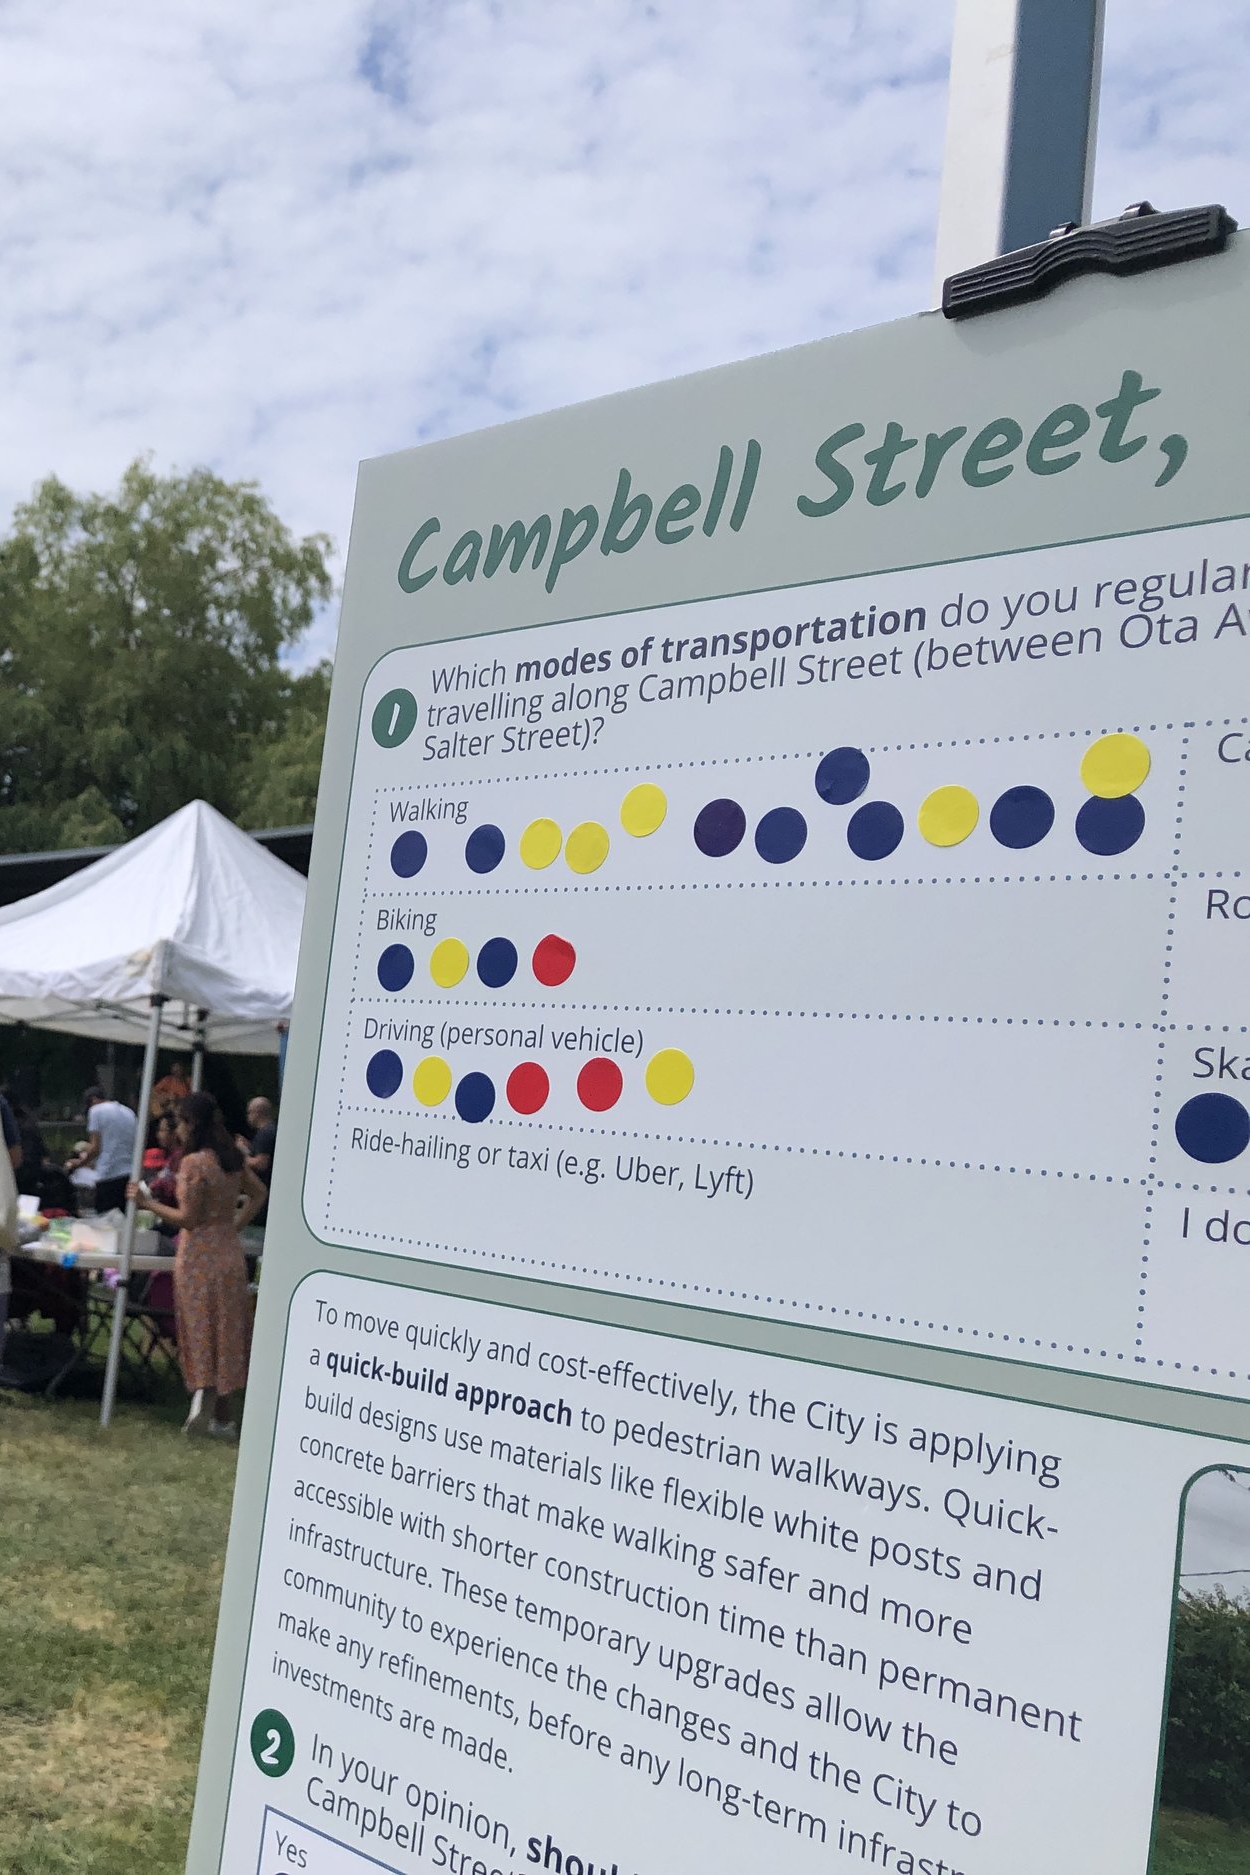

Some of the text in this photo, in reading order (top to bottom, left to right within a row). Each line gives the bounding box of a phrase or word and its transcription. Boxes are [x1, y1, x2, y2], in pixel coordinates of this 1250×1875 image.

[398, 370, 1188, 594] Campbell Street,
[427, 603, 1250, 727] travelling along Campbell Street (between Ota A
[432, 659, 506, 694] Which
[515, 647, 612, 683] modes
[621, 636, 655, 668] of
[661, 605, 926, 663] transportation
[941, 593, 989, 627] do
[1000, 586, 1078, 630] you
[423, 716, 604, 761] Salter Street)?
[390, 798, 469, 825] Walking
[377, 908, 438, 937] Biking
[364, 1018, 643, 1058] Driving (personal vehicle)
[352, 1128, 753, 1200] Ride-hailing or taxi (e.g. Uber, Lyft)
[1183, 1207, 1189, 1238] I
[310, 1348, 1058, 1539] a quick-build approach to pedestrian walkways. Quick-
[316, 1299, 1062, 1489] To move quickly and cost-effectively, the City is applying
[300, 1436, 971, 1644] concrete barriers that make walking safer and more
[305, 1385, 1042, 1601] build designs use materials like flexible white posts and
[289, 1518, 958, 1766] infrastructure. These temporary upgrades allow the
[294, 1480, 1082, 1742] accessible with shorter construction time than permanent
[259, 1728, 282, 1765] 2
[273, 1651, 512, 1773] investments are made.
[278, 1612, 964, 1875] make any refinements, before any long-term infrast
[284, 1568, 981, 1836] community to experience the changes and the City to
[276, 1830, 307, 1868] Yes
[307, 1777, 424, 1856] Campbell
[312, 1733, 333, 1768] In
[338, 1752, 399, 1796] your
[406, 1784, 516, 1858] opinion,
